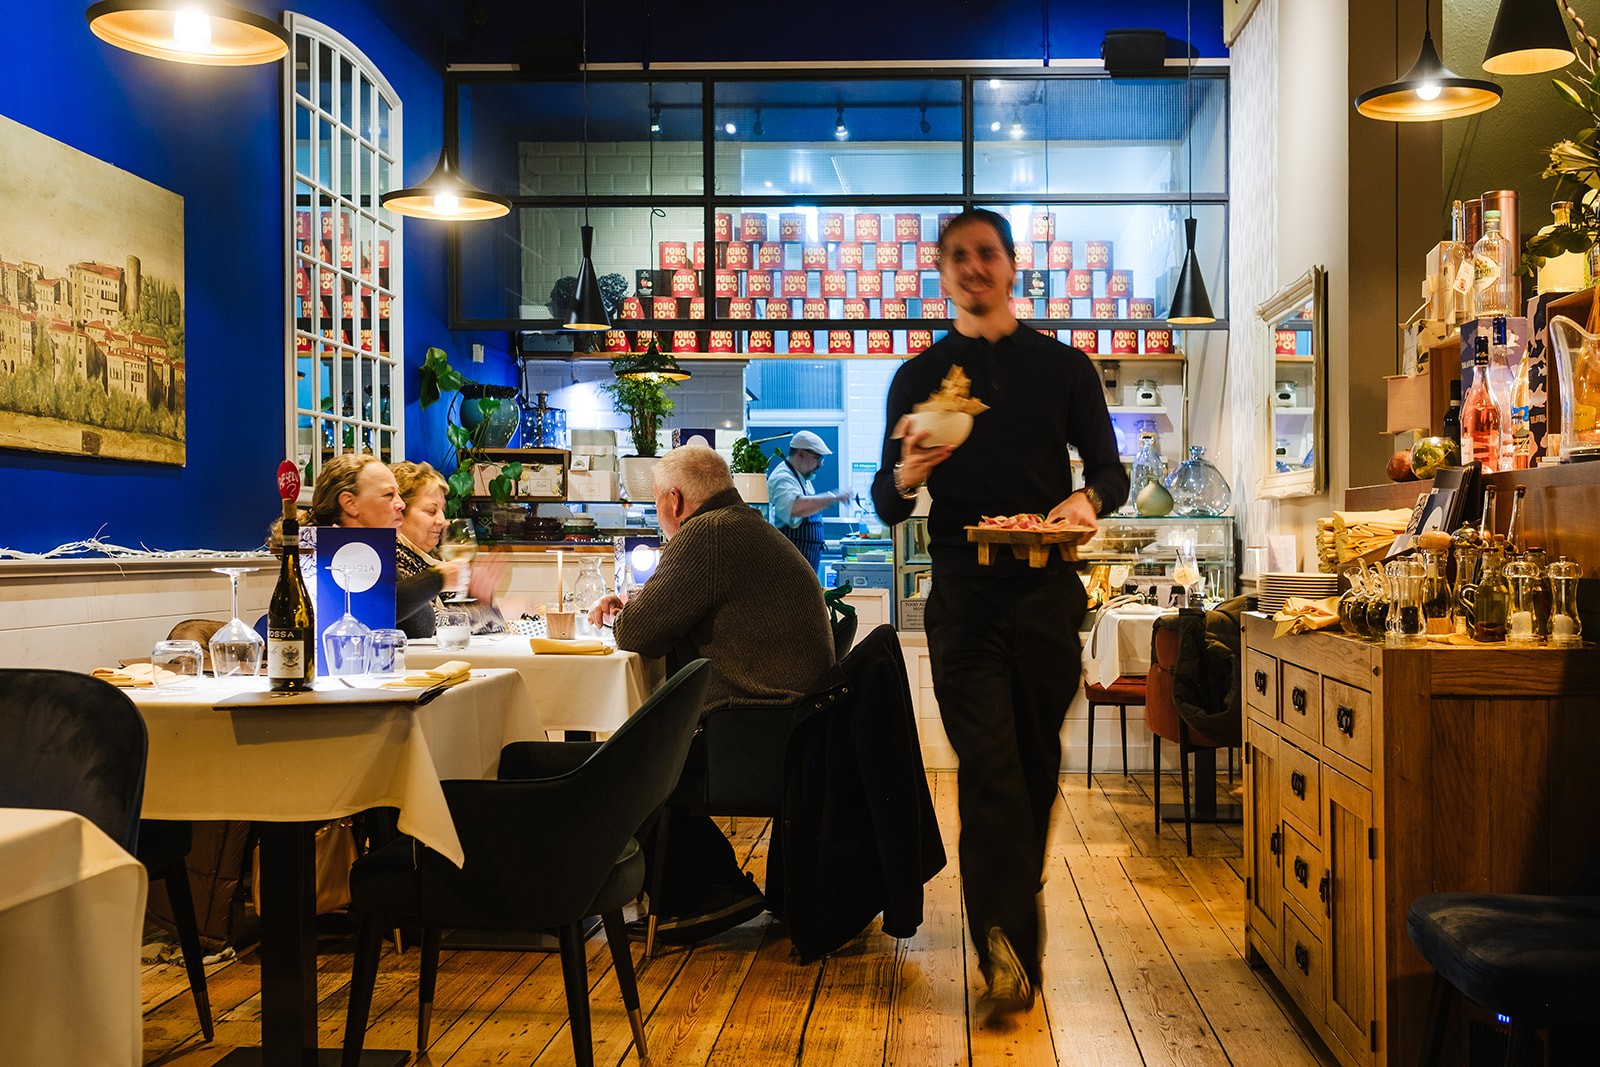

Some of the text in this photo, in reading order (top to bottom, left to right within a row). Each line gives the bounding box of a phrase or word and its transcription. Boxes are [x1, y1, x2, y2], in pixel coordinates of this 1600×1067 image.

[824, 219, 840, 227] OMO
[856, 219, 878, 227] POMO
[897, 219, 918, 227] POMO
[727, 247, 747, 255] POMO
[804, 247, 826, 255] POMO
[841, 247, 862, 255] POMO
[877, 247, 898, 255] POMO
[1014, 246, 1032, 254] OMO
[1088, 246, 1108, 254] POMO
[1015, 254, 1032, 263] OO
[673, 275, 694, 283] POMO
[784, 275, 806, 283] POMO
[824, 275, 845, 283] POMO
[858, 275, 880, 283] POMO
[895, 275, 916, 283] POMO
[624, 302, 637, 310] MO
[654, 302, 675, 310] POMO
[690, 303, 704, 311] POM
[730, 303, 751, 311] POMO
[767, 303, 787, 311] POMO
[804, 303, 824, 311] POMO
[923, 303, 944, 311] POMO
[1096, 303, 1117, 311] POMO
[674, 331, 695, 339] POMO
[711, 331, 732, 339] POMO
[751, 331, 771, 339] POMO
[830, 332, 851, 340] POMO
[868, 332, 890, 340] POMO
[910, 332, 931, 340] POMO
[1073, 331, 1095, 340] POMO
[1115, 331, 1136, 340] POMO
[1147, 331, 1168, 340] POMO
